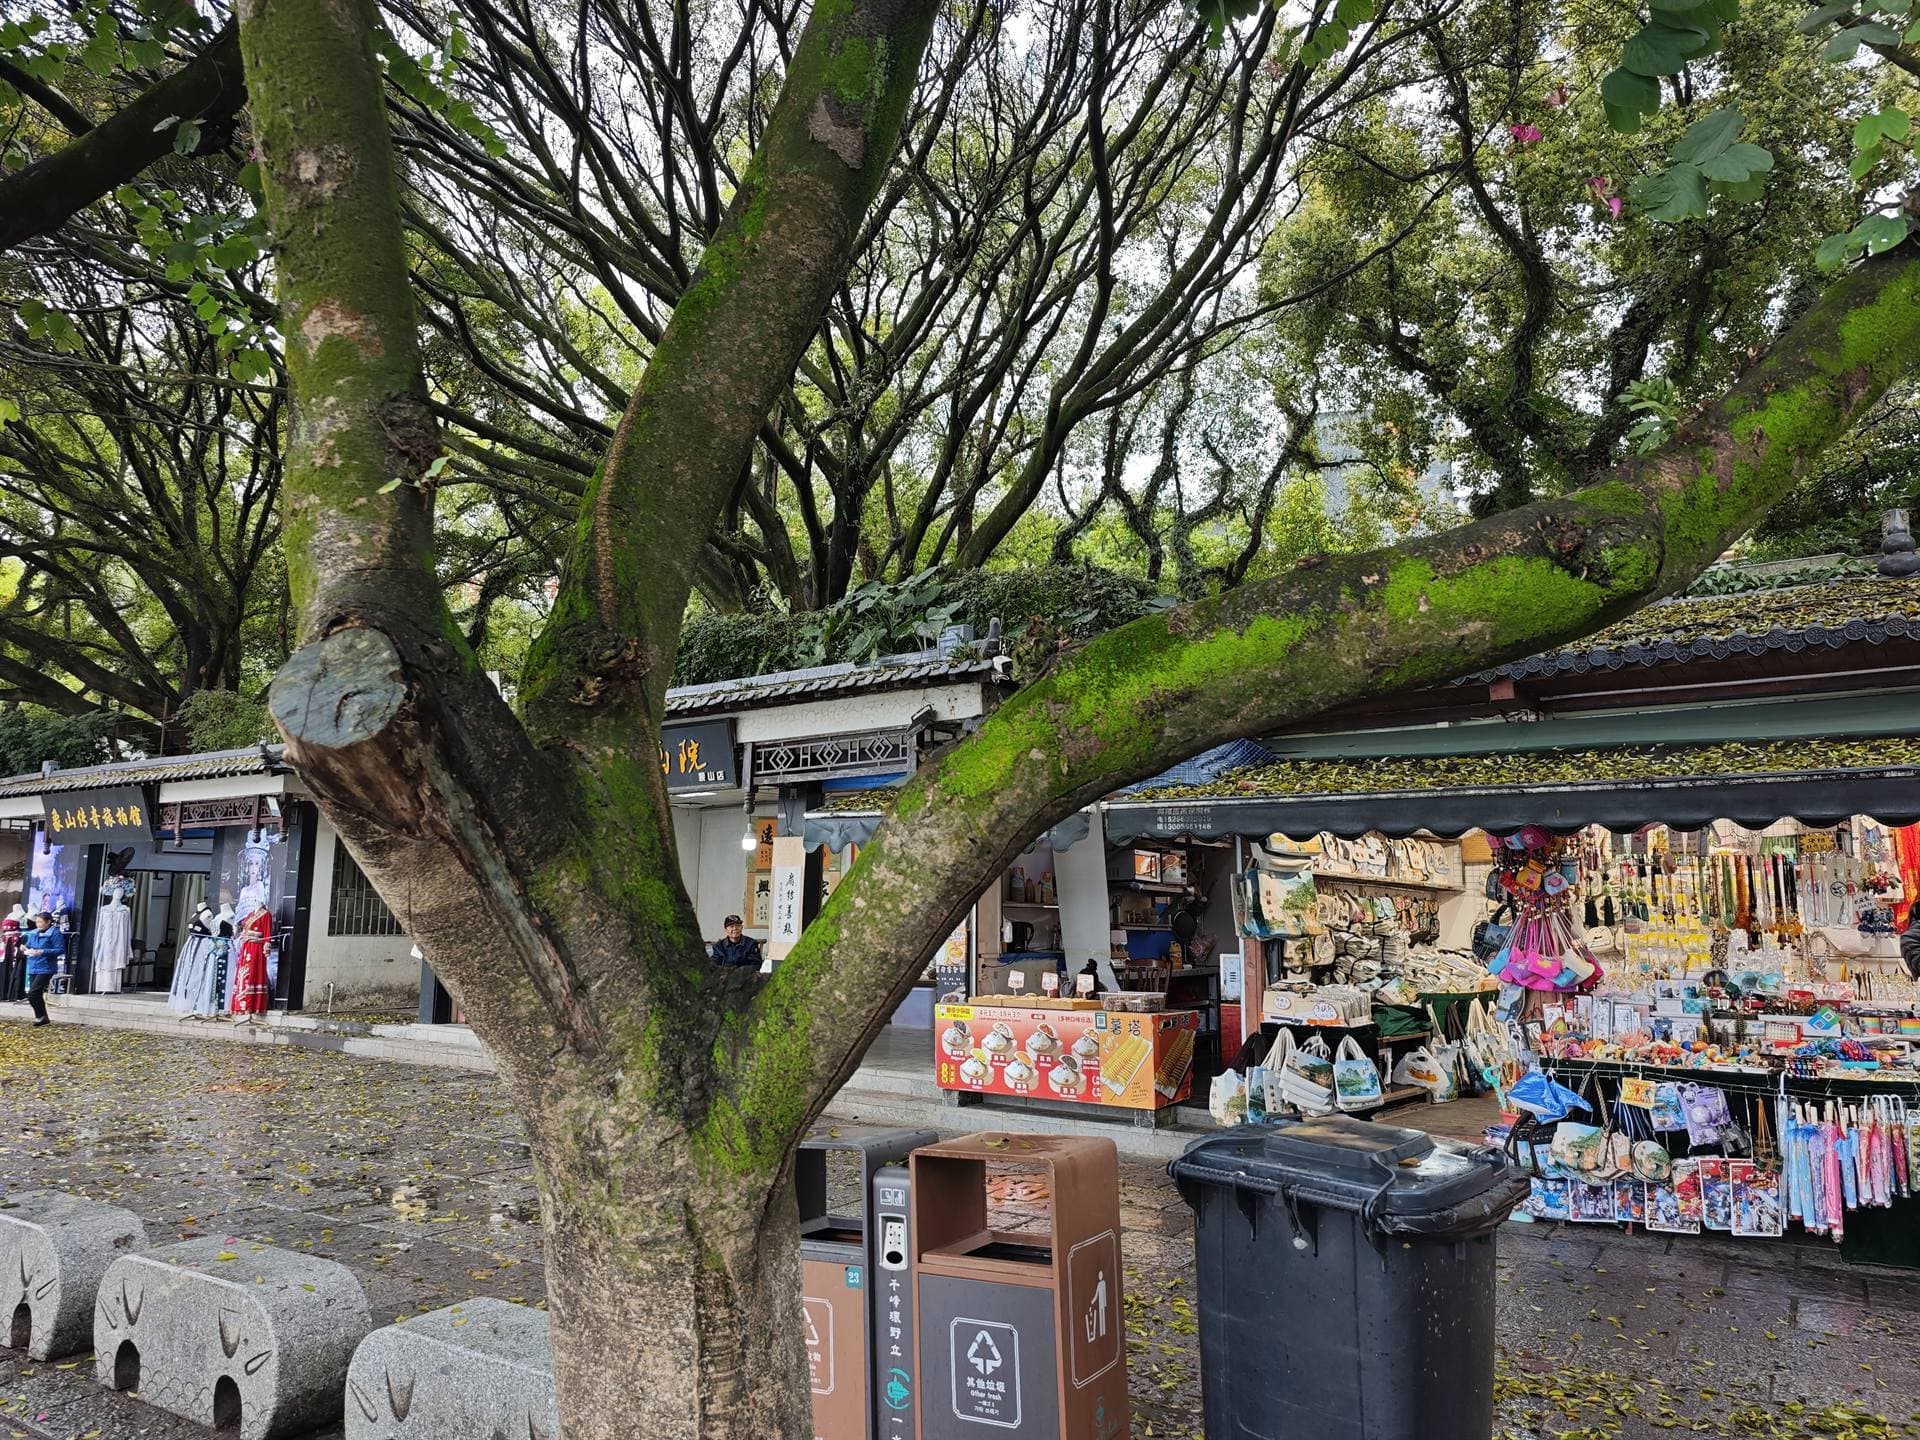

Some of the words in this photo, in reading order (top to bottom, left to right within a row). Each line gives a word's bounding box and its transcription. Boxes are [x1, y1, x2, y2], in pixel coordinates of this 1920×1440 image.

[848, 1272, 860, 1284] 23
[967, 1376, 1006, 1393] 其他垃圾
[970, 1390, 985, 1398] Other
[987, 1392, 1002, 1401] trash
